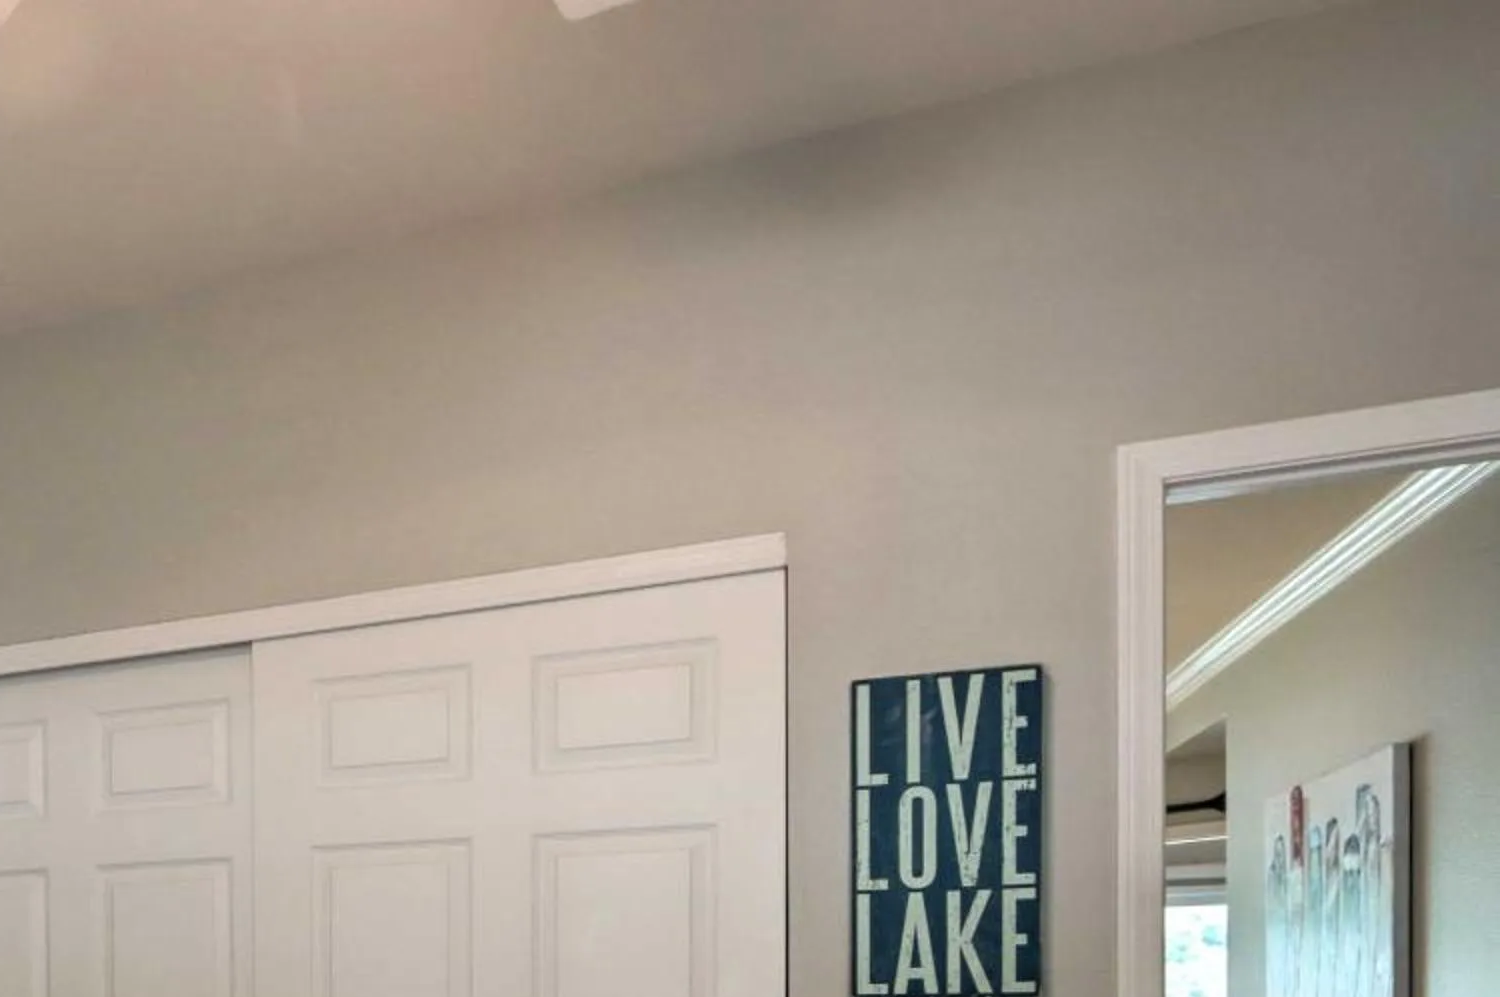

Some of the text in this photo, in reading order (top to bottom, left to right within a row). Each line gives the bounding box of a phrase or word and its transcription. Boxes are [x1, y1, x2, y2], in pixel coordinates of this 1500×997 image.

[855, 667, 1038, 787] LIVE
[855, 777, 1038, 892] LOVE
[855, 886, 1038, 996] LAKE
